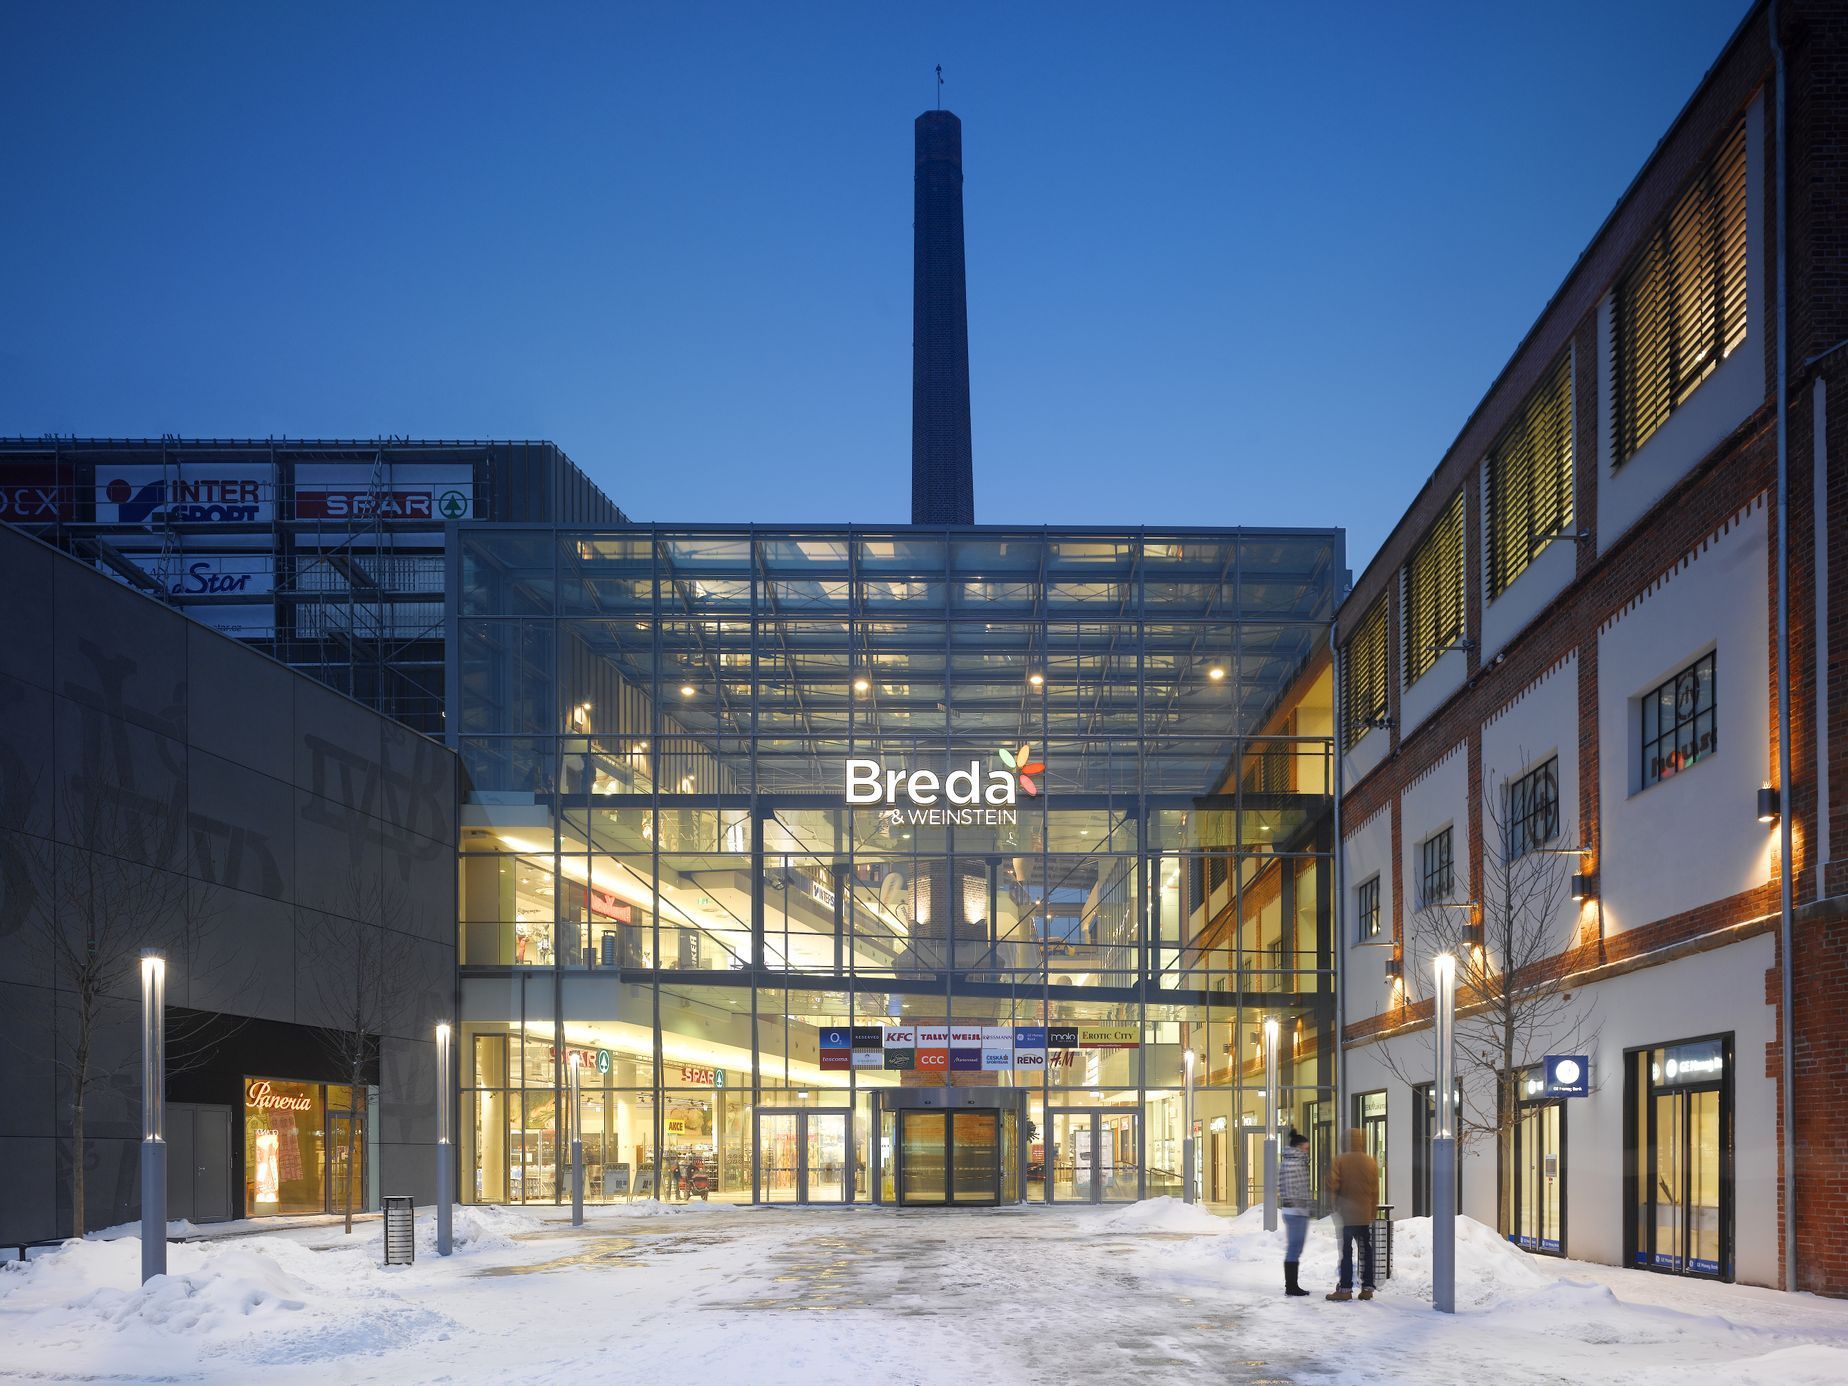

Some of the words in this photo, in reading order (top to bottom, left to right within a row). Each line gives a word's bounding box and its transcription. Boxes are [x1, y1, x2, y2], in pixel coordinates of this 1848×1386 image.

[172, 479, 259, 503] INTER
[326, 495, 430, 515] SPAR
[845, 759, 1017, 805] Breda
[891, 808, 904, 825] &
[908, 809, 1017, 825] WEINSTEIN
[886, 1032, 913, 1042] KFC
[920, 1033, 948, 1041] TALLY
[921, 1055, 945, 1065] CCC
[1016, 1056, 1044, 1065] RENO
[683, 1067, 715, 1085] SPAR
[245, 1081, 312, 1111] Paneria
